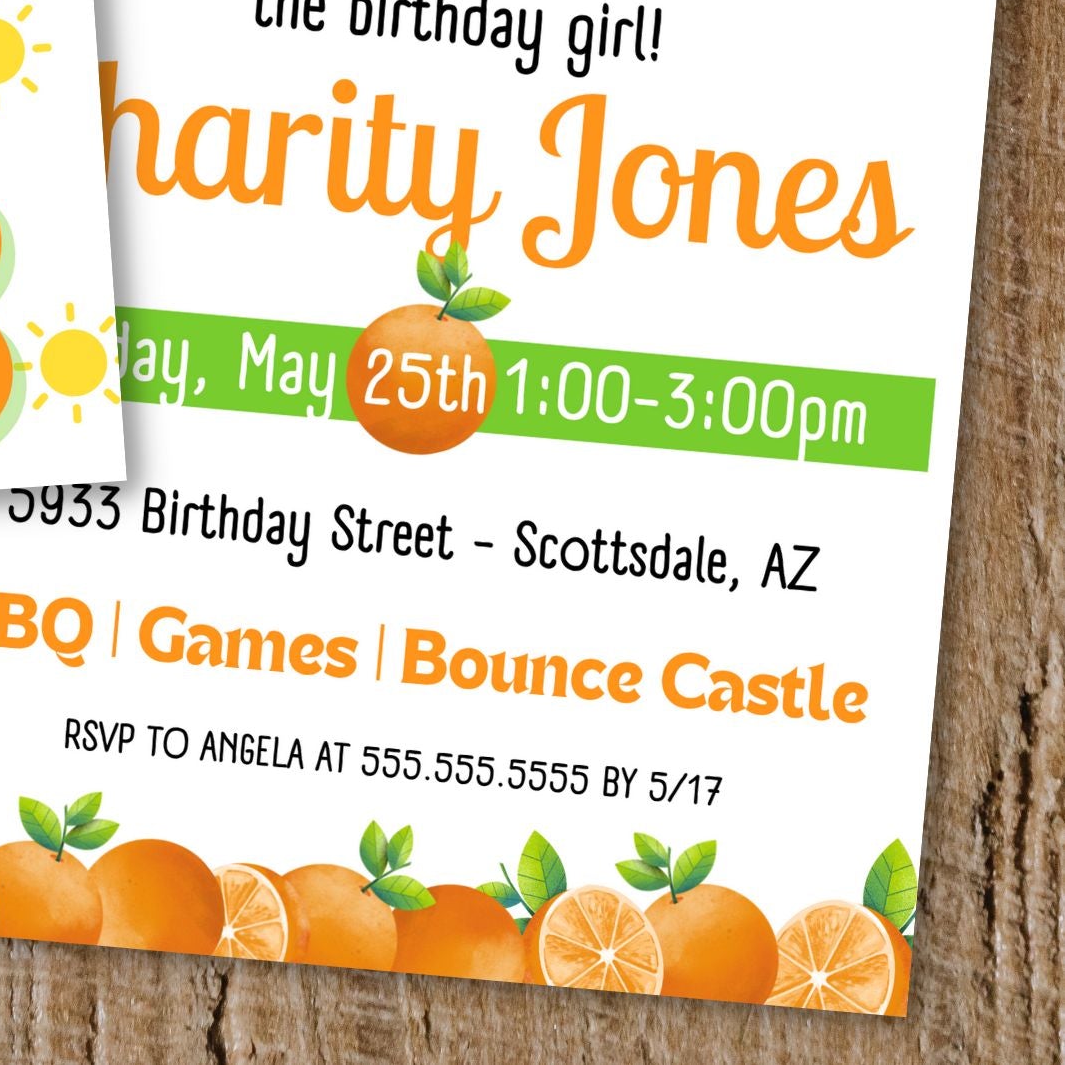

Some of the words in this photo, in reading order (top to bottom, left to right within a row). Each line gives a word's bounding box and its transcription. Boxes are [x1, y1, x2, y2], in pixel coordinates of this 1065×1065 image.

[567, 2, 662, 78] girl!
[522, 94, 914, 269] Jones
[238, 331, 336, 419] May
[363, 347, 487, 415] 25th
[506, 357, 868, 461] 1:00-3:00pm
[142, 487, 311, 568] Birthday
[331, 503, 454, 561] Street
[514, 520, 739, 593] Scottsdale,
[760, 542, 821, 592] AZ
[139, 606, 358, 678] Games
[402, 628, 643, 704] Bounce
[662, 652, 868, 724] Castle
[64, 717, 135, 754] RSVP
[147, 725, 189, 760] TO
[199, 730, 304, 770] ANGELA
[314, 740, 351, 773] AT
[361, 745, 589, 795] 555.555.5555
[602, 765, 638, 799] BY
[649, 771, 723, 806] 5/17
